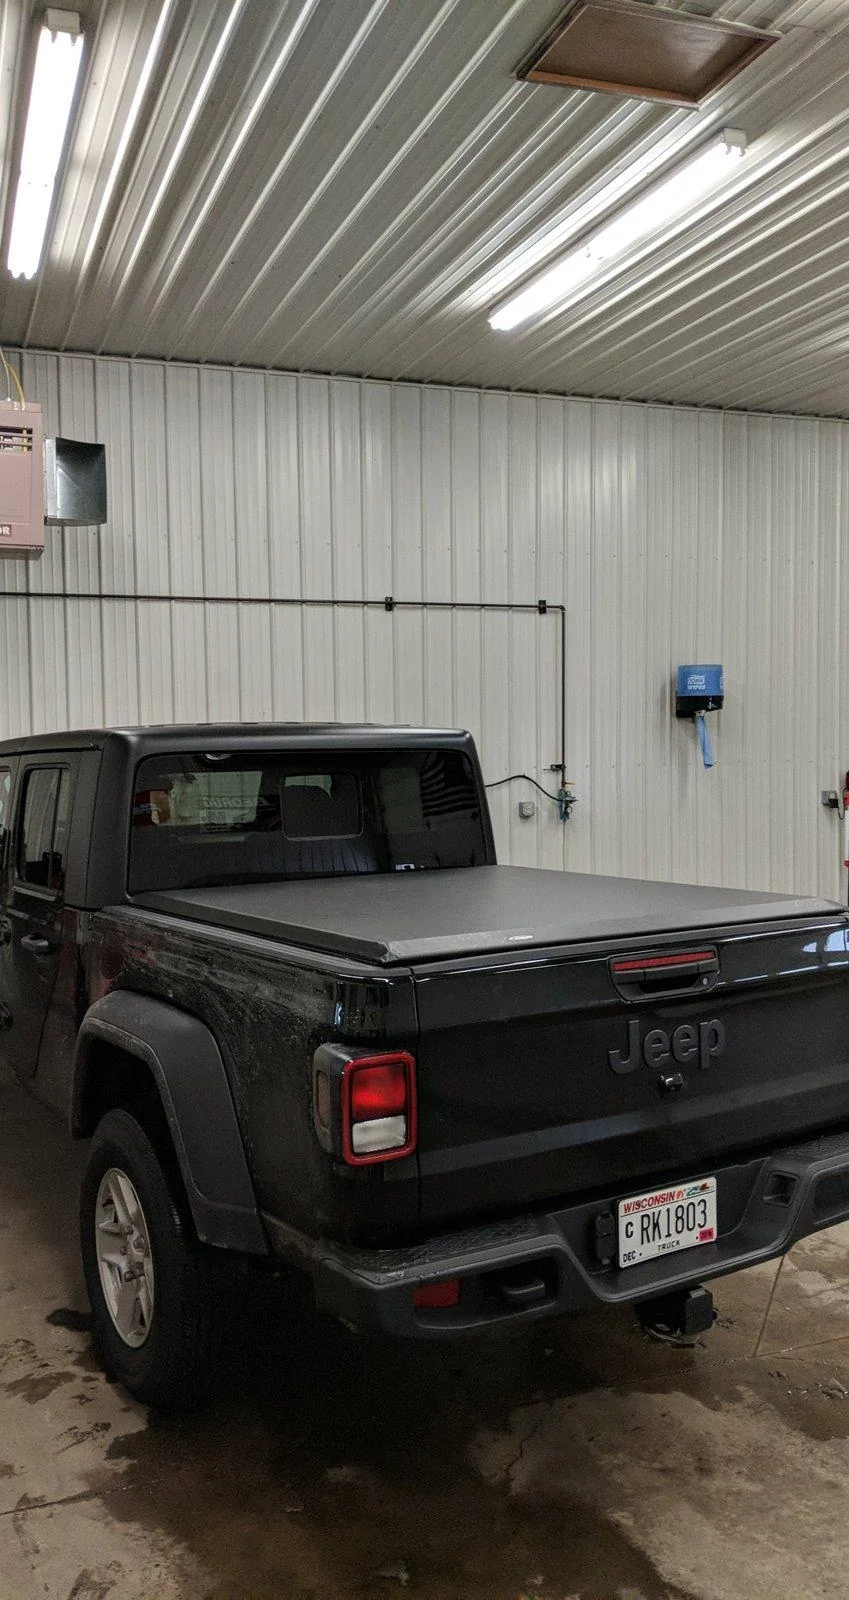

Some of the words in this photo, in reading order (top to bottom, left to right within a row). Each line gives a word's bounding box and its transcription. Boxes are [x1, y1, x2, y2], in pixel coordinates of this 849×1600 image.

[608, 1019, 726, 1074] Jeep
[623, 1190, 676, 1214] WISCONSIN
[625, 1221, 634, 1239] C
[640, 1198, 707, 1246] RK1803
[622, 1250, 637, 1263] DEC
[657, 1240, 681, 1252] TRUCK
